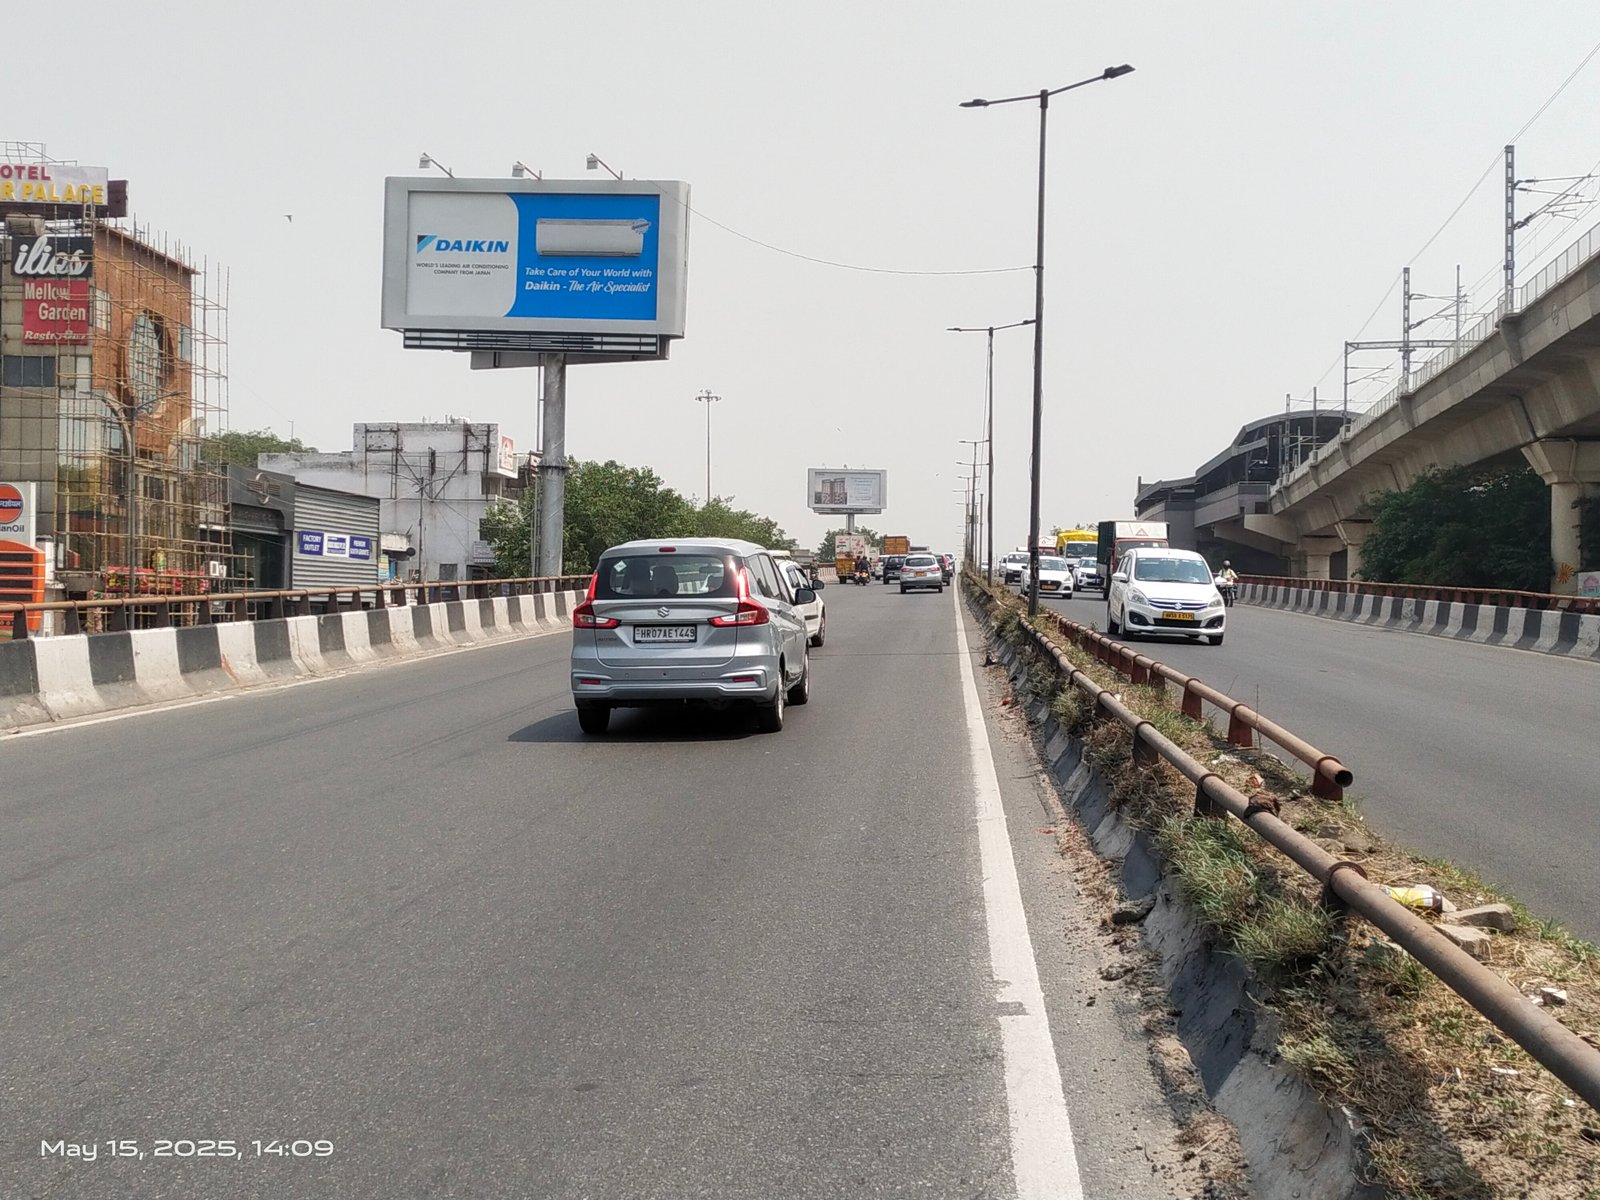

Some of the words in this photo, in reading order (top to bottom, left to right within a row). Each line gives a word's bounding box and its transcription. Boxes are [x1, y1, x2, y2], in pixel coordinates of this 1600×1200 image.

[0, 165, 51, 181] OTEL
[1, 181, 15, 200] R
[22, 182, 104, 204] PALACE
[435, 239, 510, 253] DAIKIN
[525, 267, 545, 277] Take
[547, 267, 566, 277] Care
[569, 268, 579, 277] of
[581, 268, 601, 277] Your
[603, 268, 630, 277] World
[632, 268, 652, 278] with
[25, 282, 70, 300] Mellow
[525, 281, 560, 291] Daikin
[569, 280, 585, 292] The
[586, 281, 603, 294] Air
[604, 281, 650, 294] Specialist
[38, 302, 86, 321] Garden
[303, 534, 322, 543] FACTORY
[304, 543, 320, 551] OUTLET
[640, 627, 695, 638] HR07AE1449
